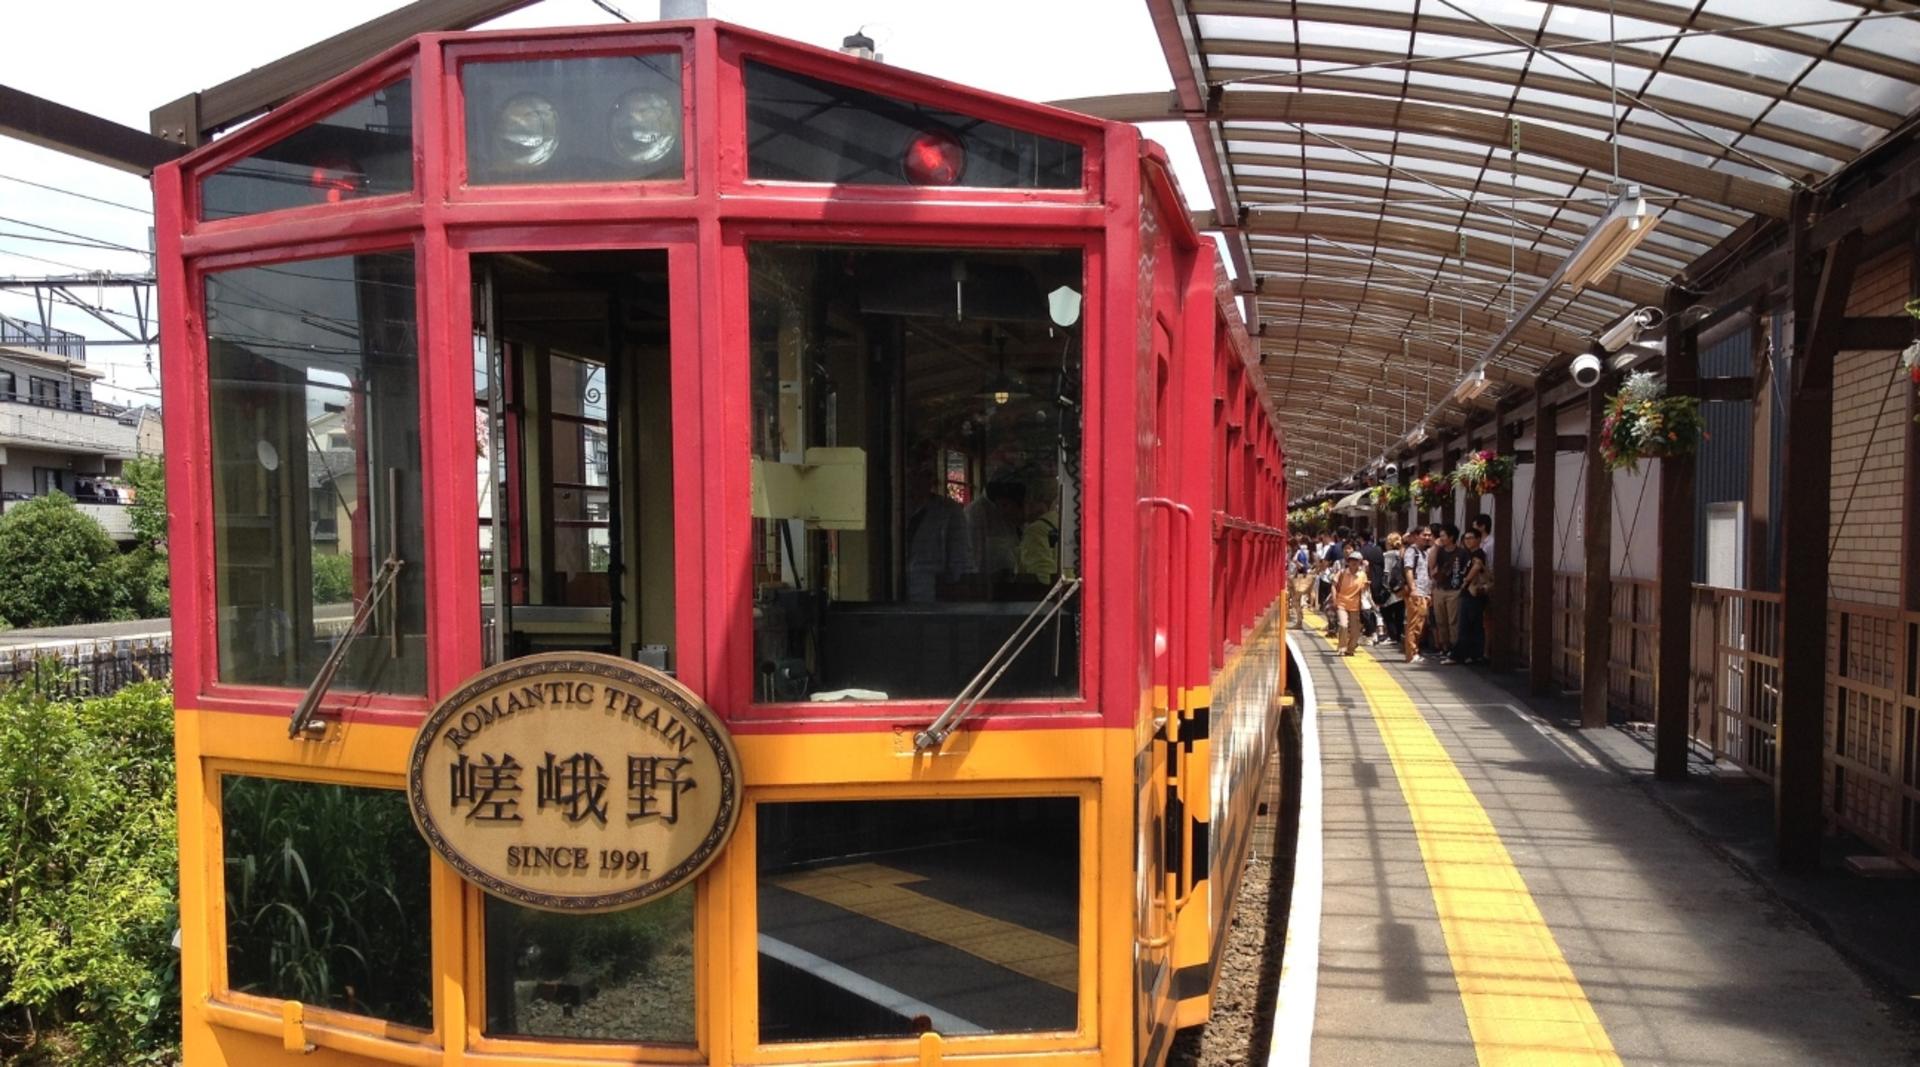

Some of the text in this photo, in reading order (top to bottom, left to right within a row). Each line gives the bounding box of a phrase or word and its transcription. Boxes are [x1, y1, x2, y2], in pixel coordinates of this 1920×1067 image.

[444, 681, 698, 752] ROMANTIC TRAIN
[450, 751, 697, 825] 嵯峨野
[507, 845, 650, 871] SINCE 1991
